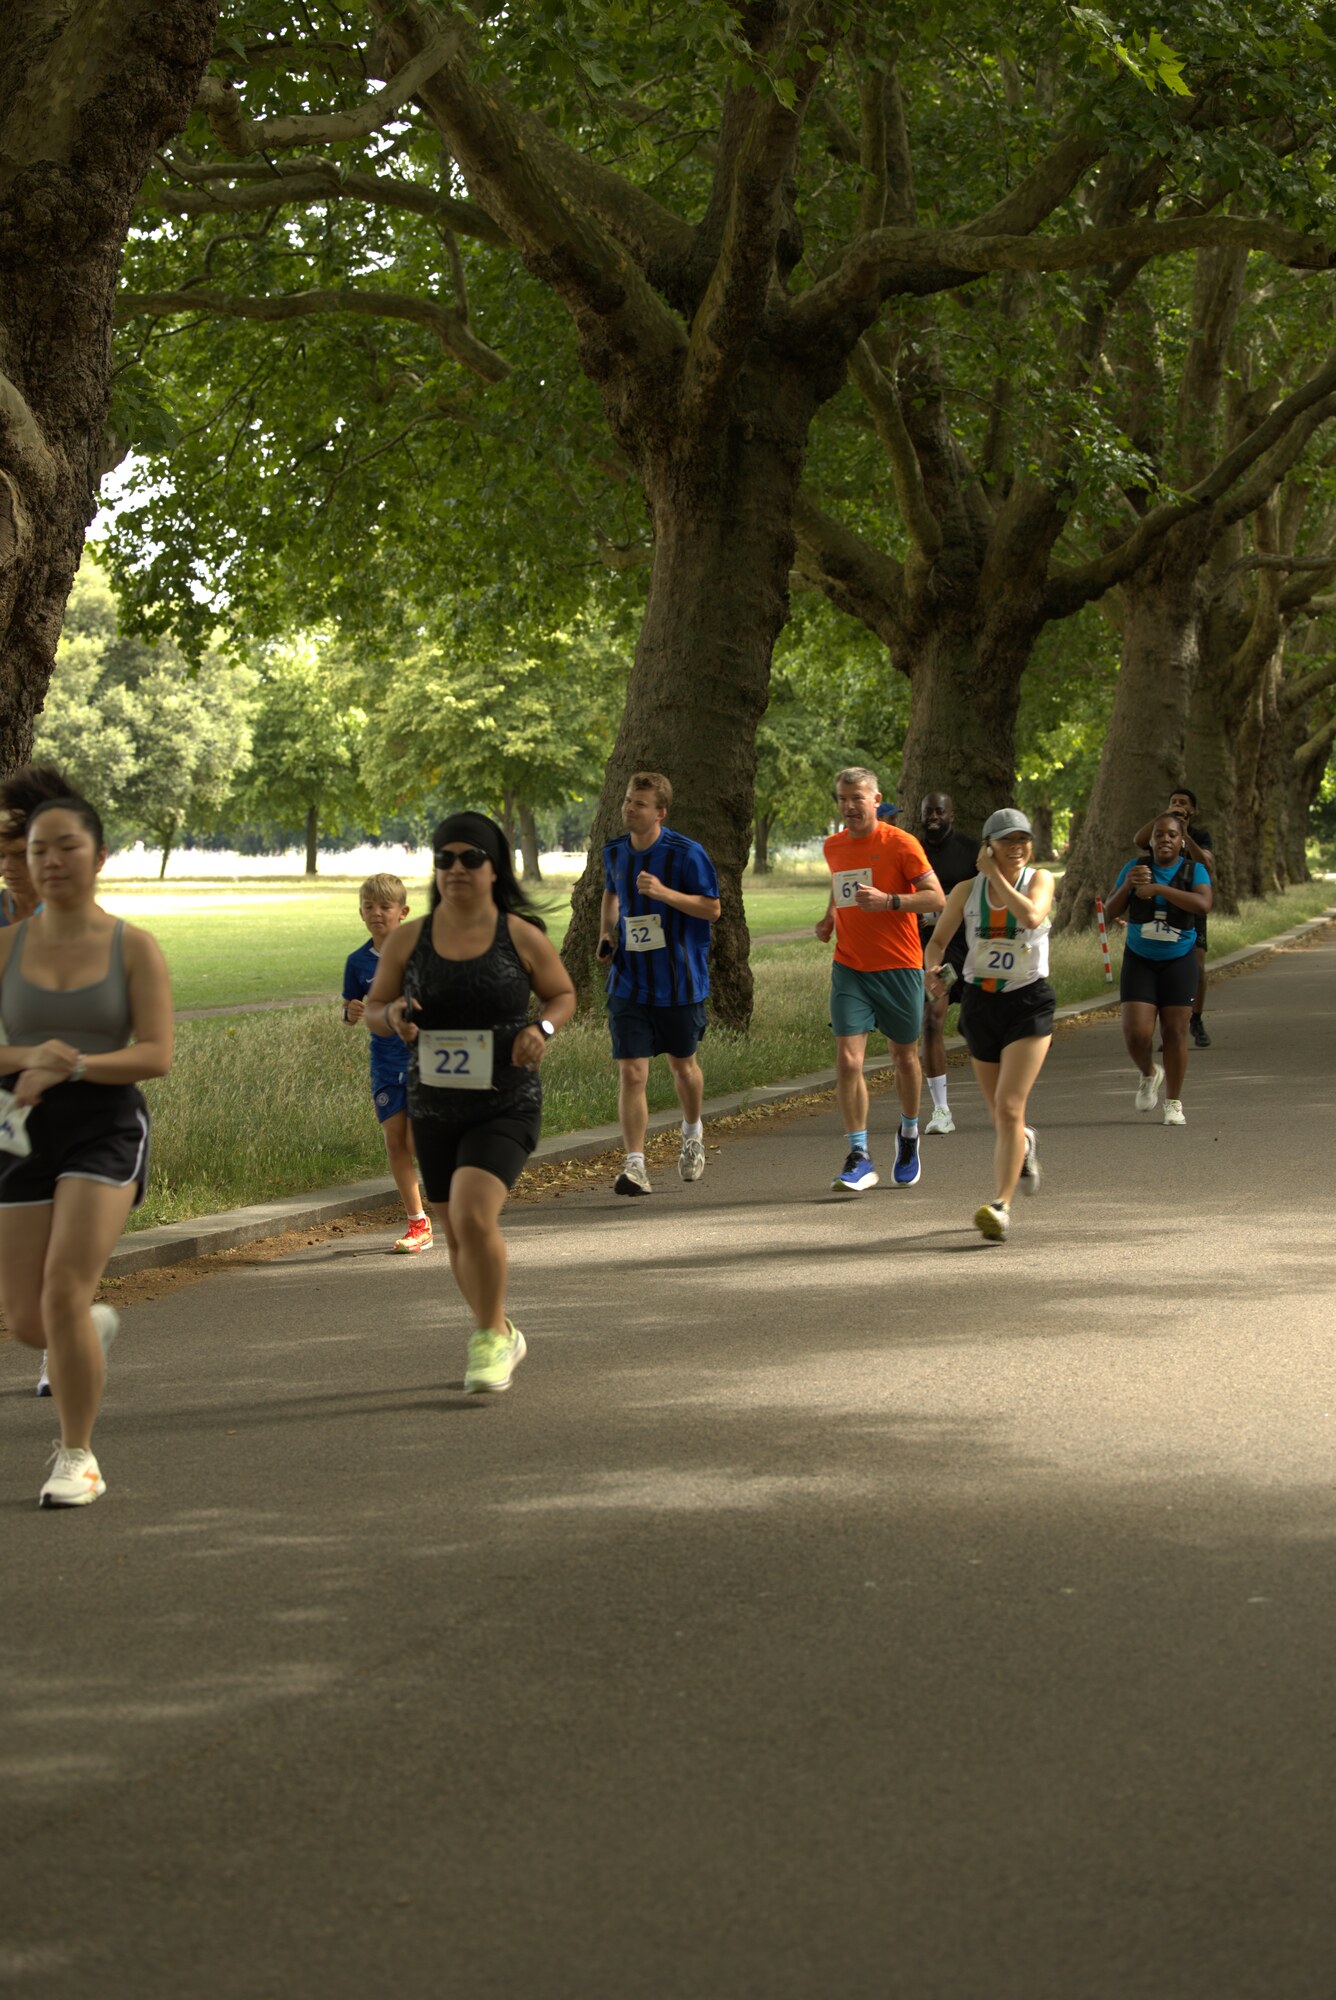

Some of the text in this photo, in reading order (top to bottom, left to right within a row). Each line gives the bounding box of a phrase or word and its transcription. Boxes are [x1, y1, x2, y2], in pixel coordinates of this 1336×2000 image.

[842, 881, 859, 898] 61
[1153, 920, 1171, 933] 14
[988, 951, 1014, 970] 20
[434, 1049, 470, 1074] 22
